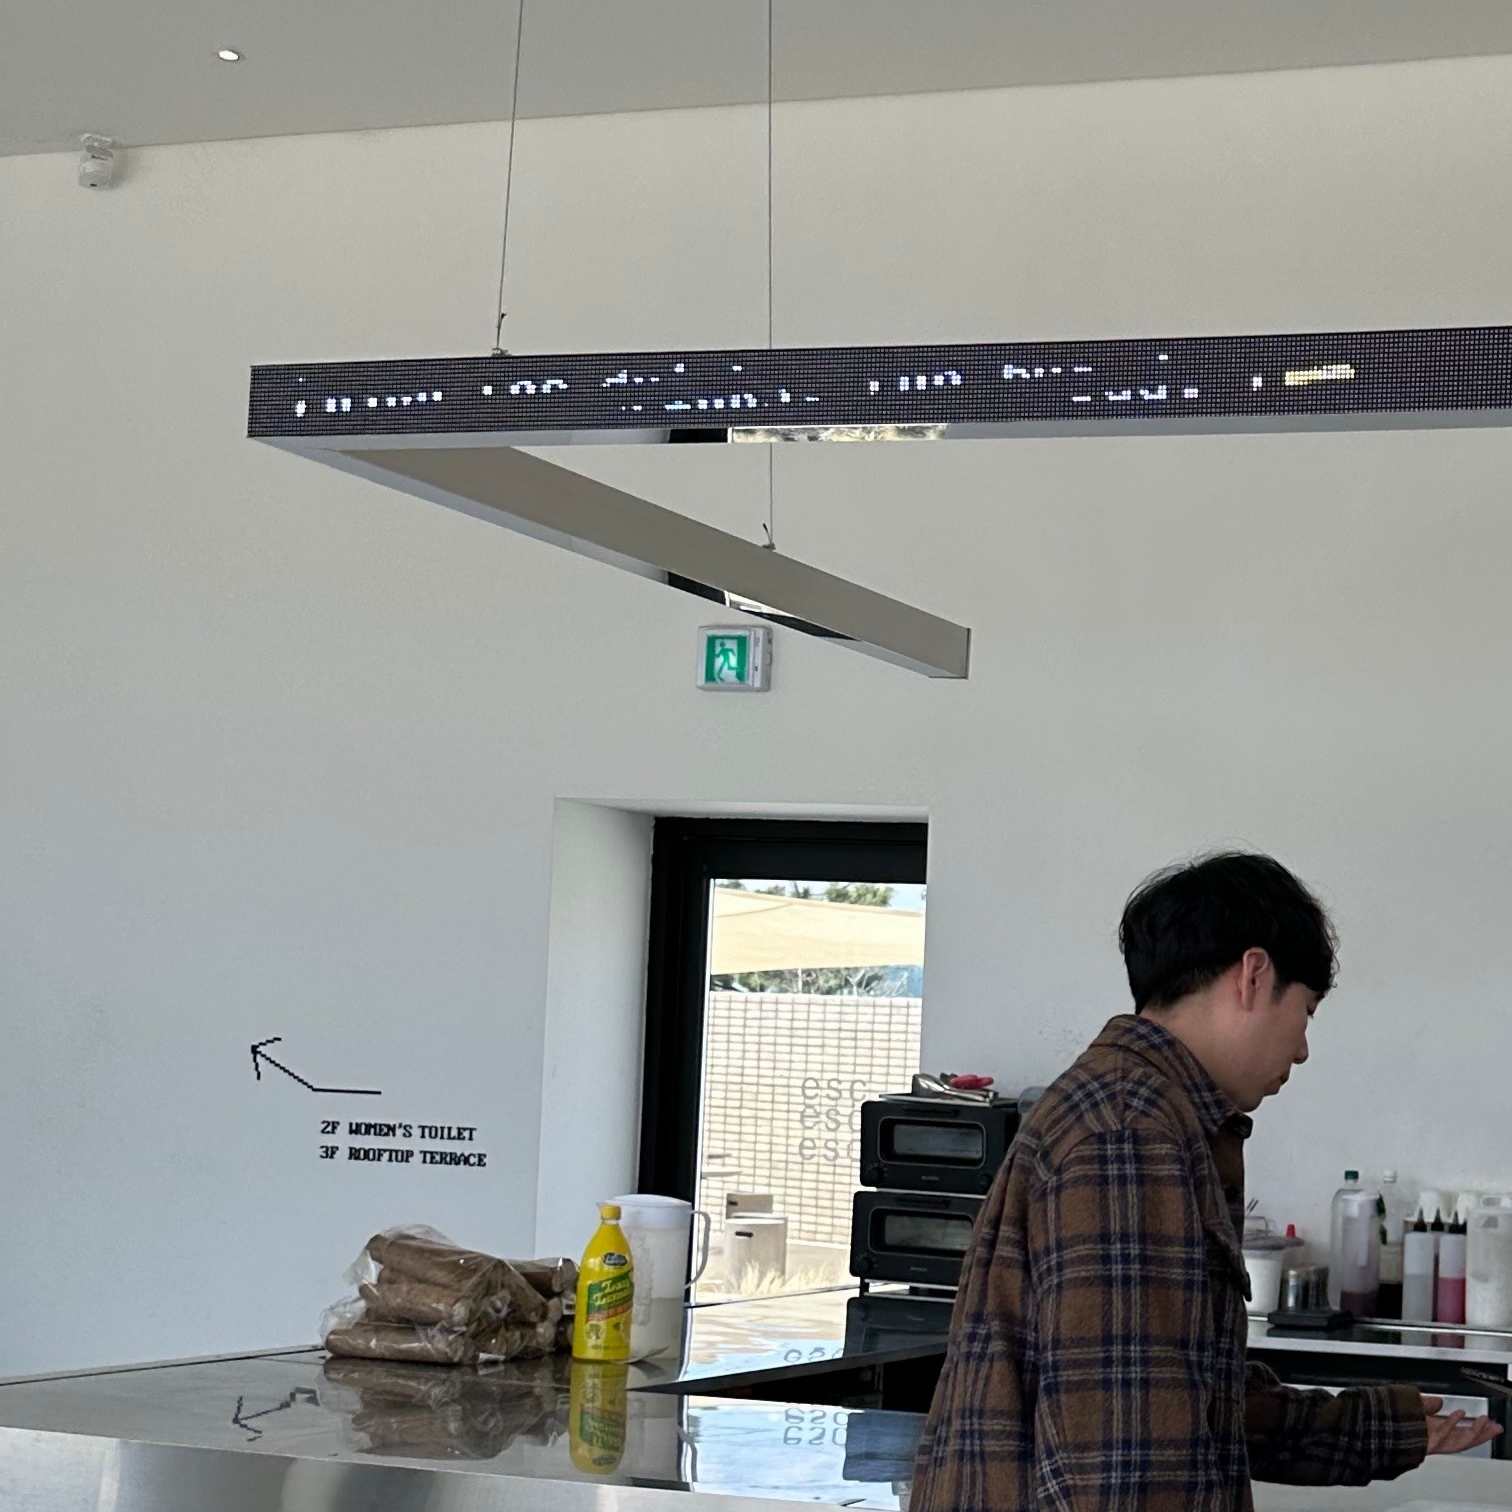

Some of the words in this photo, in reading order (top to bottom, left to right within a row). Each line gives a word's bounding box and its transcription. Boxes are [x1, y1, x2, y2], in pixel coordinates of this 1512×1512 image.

[801, 1077, 866, 1102] esc
[320, 1120, 340, 1134] 2F
[348, 1121, 413, 1138] WOMEN'S
[418, 1125, 477, 1141] TOILET
[319, 1145, 339, 1159] 3F
[347, 1146, 414, 1163] ROOFTOP
[419, 1150, 487, 1167] TERRACE
